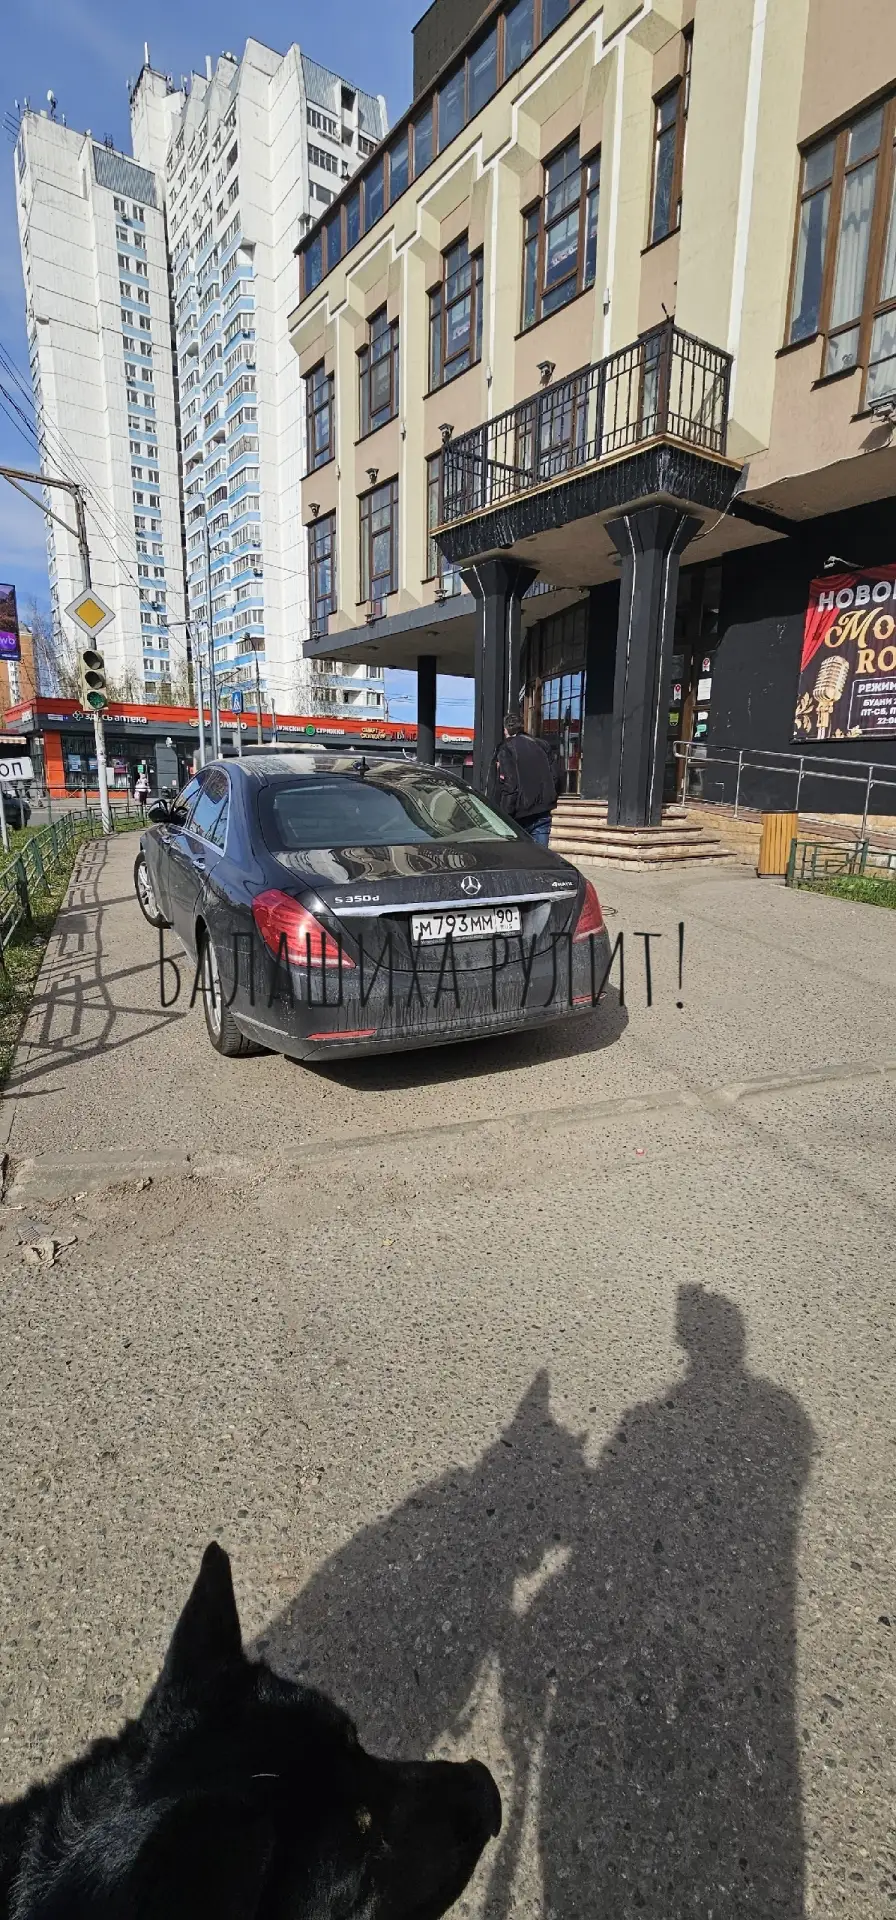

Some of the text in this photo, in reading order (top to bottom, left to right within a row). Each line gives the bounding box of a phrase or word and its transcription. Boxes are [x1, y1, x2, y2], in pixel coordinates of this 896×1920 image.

[818, 579, 896, 613] НОВО
[114, 714, 148, 724] аптека
[334, 895, 380, 904] S 350d
[420, 914, 493, 937] М793ММ
[496, 909, 513, 924] 90
